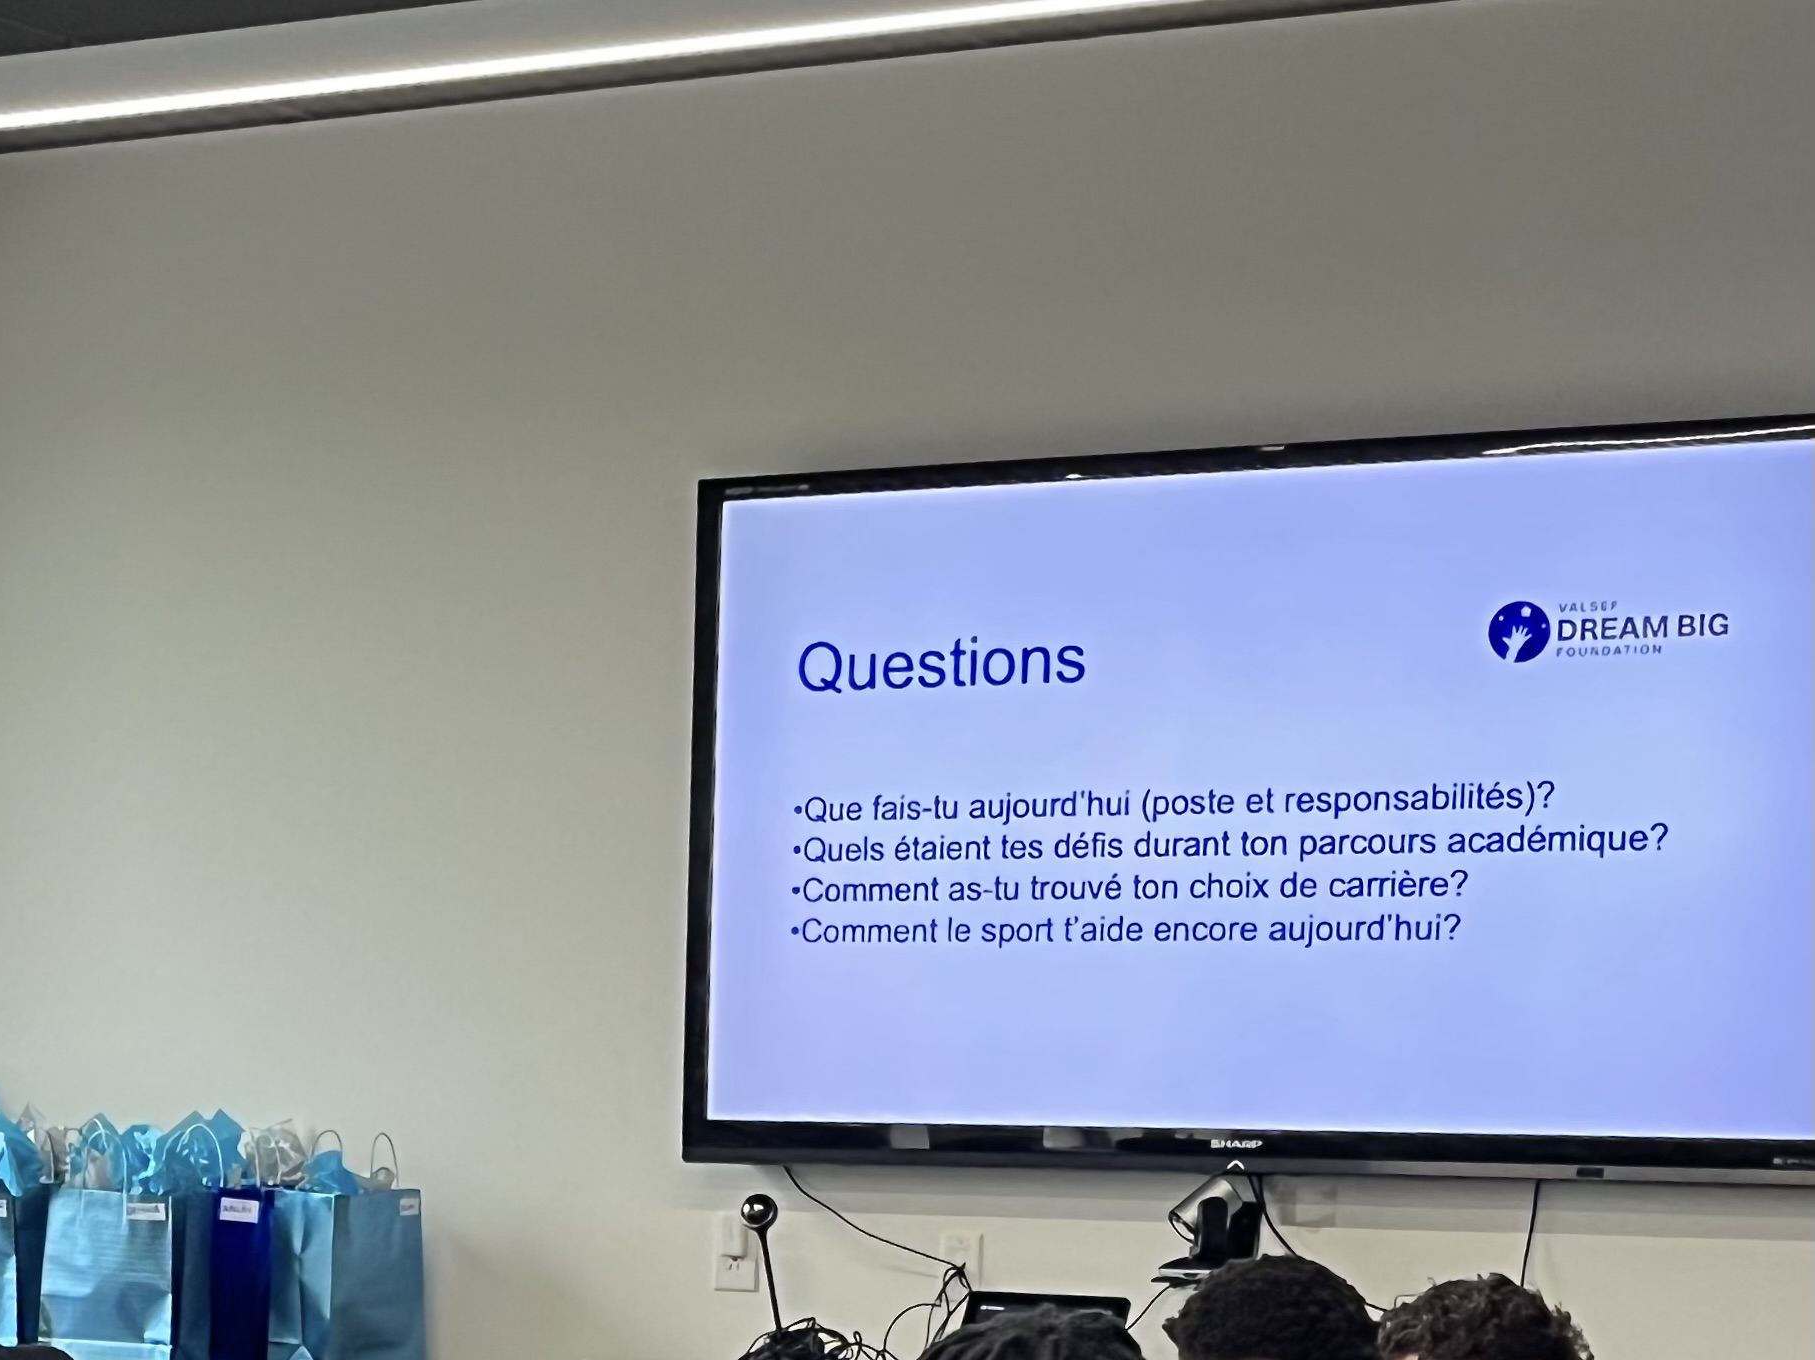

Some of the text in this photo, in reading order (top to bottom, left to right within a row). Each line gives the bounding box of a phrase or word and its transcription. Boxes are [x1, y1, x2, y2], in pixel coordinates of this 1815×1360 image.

[1556, 612, 1730, 642] DREAM BIG
[798, 635, 1086, 695] Questions
[1555, 644, 1663, 658] FOUNDATION
[804, 780, 1556, 826] Que fais-tu aujourd'hui (poste et responsabilités)?
[803, 822, 1669, 864] Quels étaient tes défis durant ton parcours académique?
[802, 869, 1469, 903] Comment as-tu trouvé ton choix de carrière?
[801, 917, 939, 944] Comment
[947, 916, 971, 943] le
[980, 917, 1054, 949] sport
[1153, 921, 1258, 942] encore
